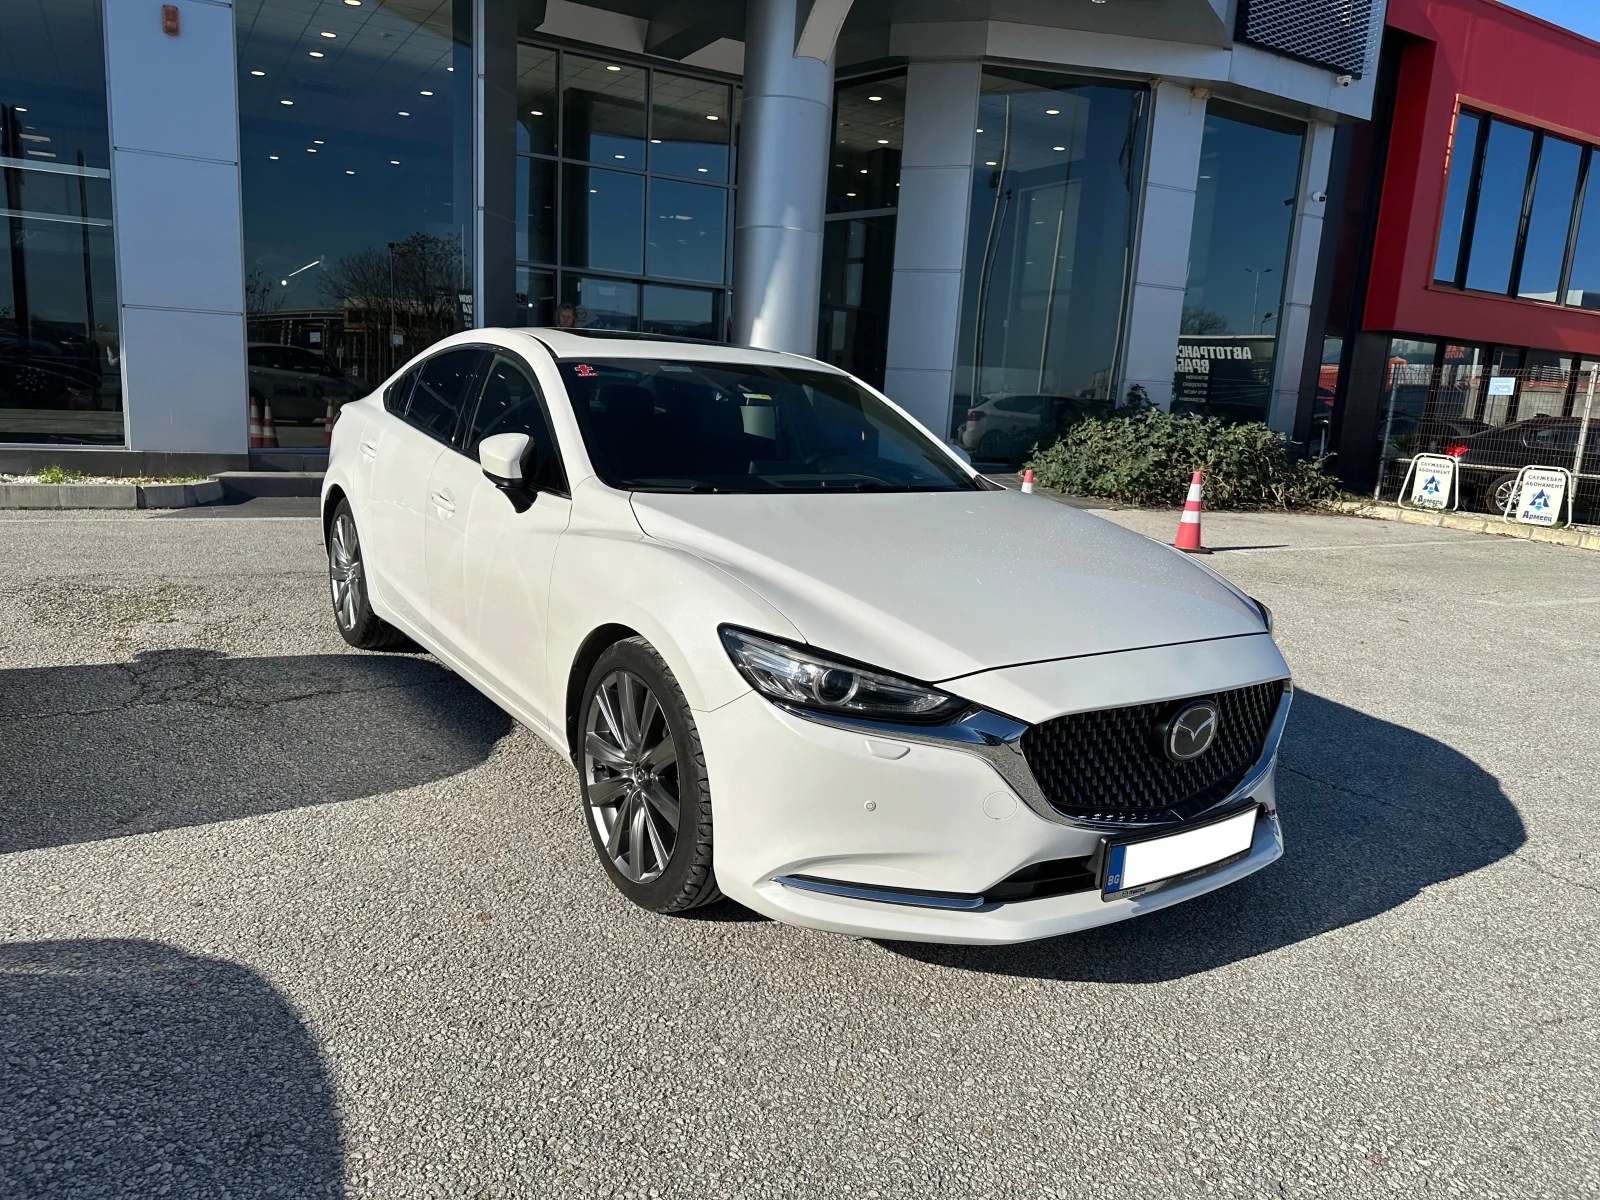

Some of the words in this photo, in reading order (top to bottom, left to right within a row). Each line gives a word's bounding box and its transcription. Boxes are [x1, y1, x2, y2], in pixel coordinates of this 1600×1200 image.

[1420, 461, 1450, 469] СЛУЖЕБЕН
[1418, 467, 1451, 475] АБОНАМЕНТ
[1528, 474, 1563, 482] СЛУЖЕБЕН
[1525, 481, 1563, 489] АБОНАМЕНТ
[1522, 510, 1552, 523] Армеец
[1107, 874, 1121, 886] BG
